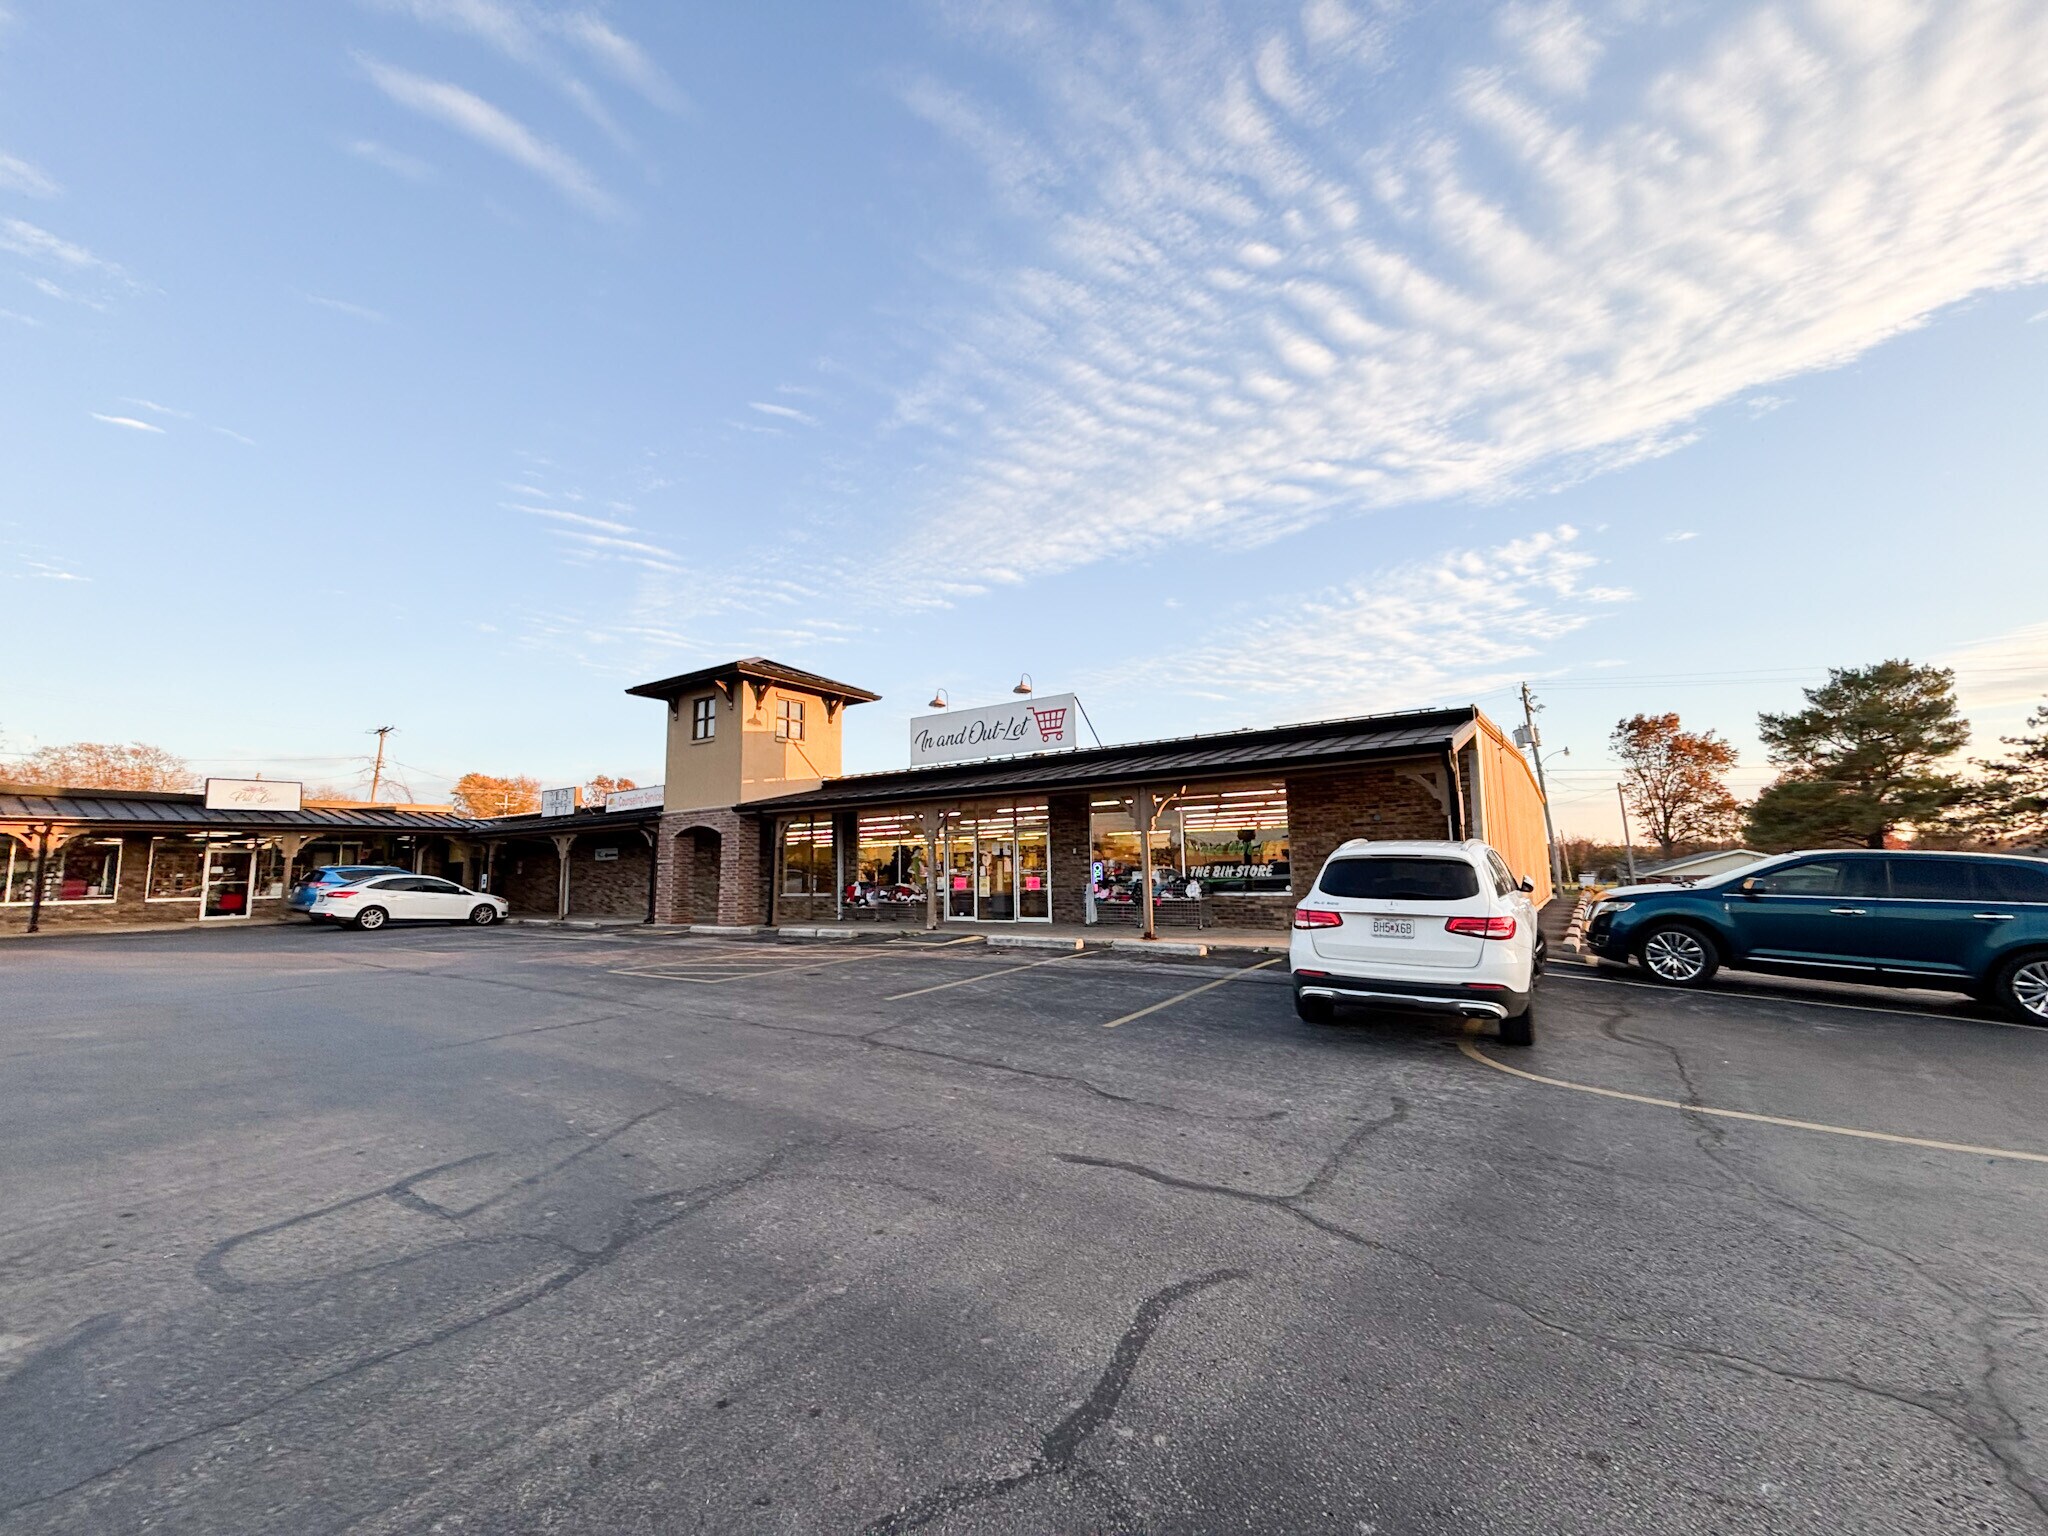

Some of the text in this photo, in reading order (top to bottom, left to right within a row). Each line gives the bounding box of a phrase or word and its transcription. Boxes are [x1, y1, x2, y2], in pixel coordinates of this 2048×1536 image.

[915, 715, 1032, 752] In and Out-Let
[619, 791, 664, 807] Counseling Services
[1190, 866, 1211, 878] THE
[1237, 864, 1274, 877] STORE
